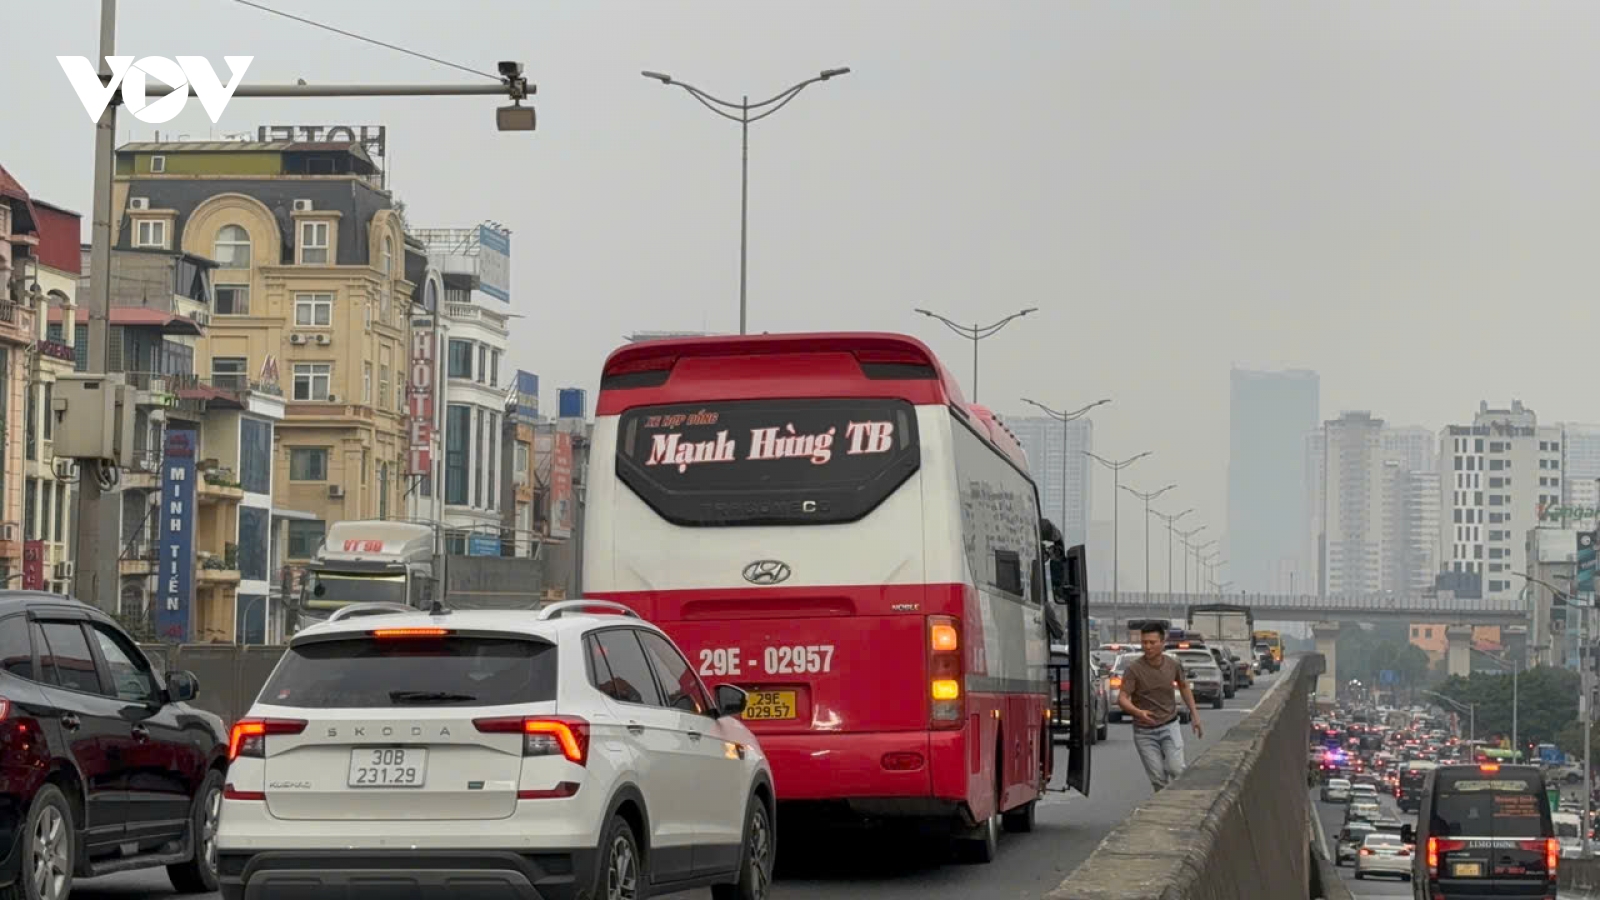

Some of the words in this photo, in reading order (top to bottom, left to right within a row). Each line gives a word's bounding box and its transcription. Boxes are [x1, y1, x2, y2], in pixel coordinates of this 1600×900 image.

[409, 331, 433, 475] HOTEL
[645, 430, 736, 474] Mạnh
[745, 422, 836, 465] Hùng
[845, 420, 894, 455] TB
[170, 467, 185, 532] MINH
[166, 544, 181, 611] TIẾN
[699, 648, 741, 676] 29E
[763, 644, 835, 674] 02957
[746, 704, 791, 718] 029.57
[756, 693, 780, 705] 29E
[327, 726, 451, 738] SKODA
[371, 750, 405, 766] 30B
[355, 767, 417, 784] 231.29
